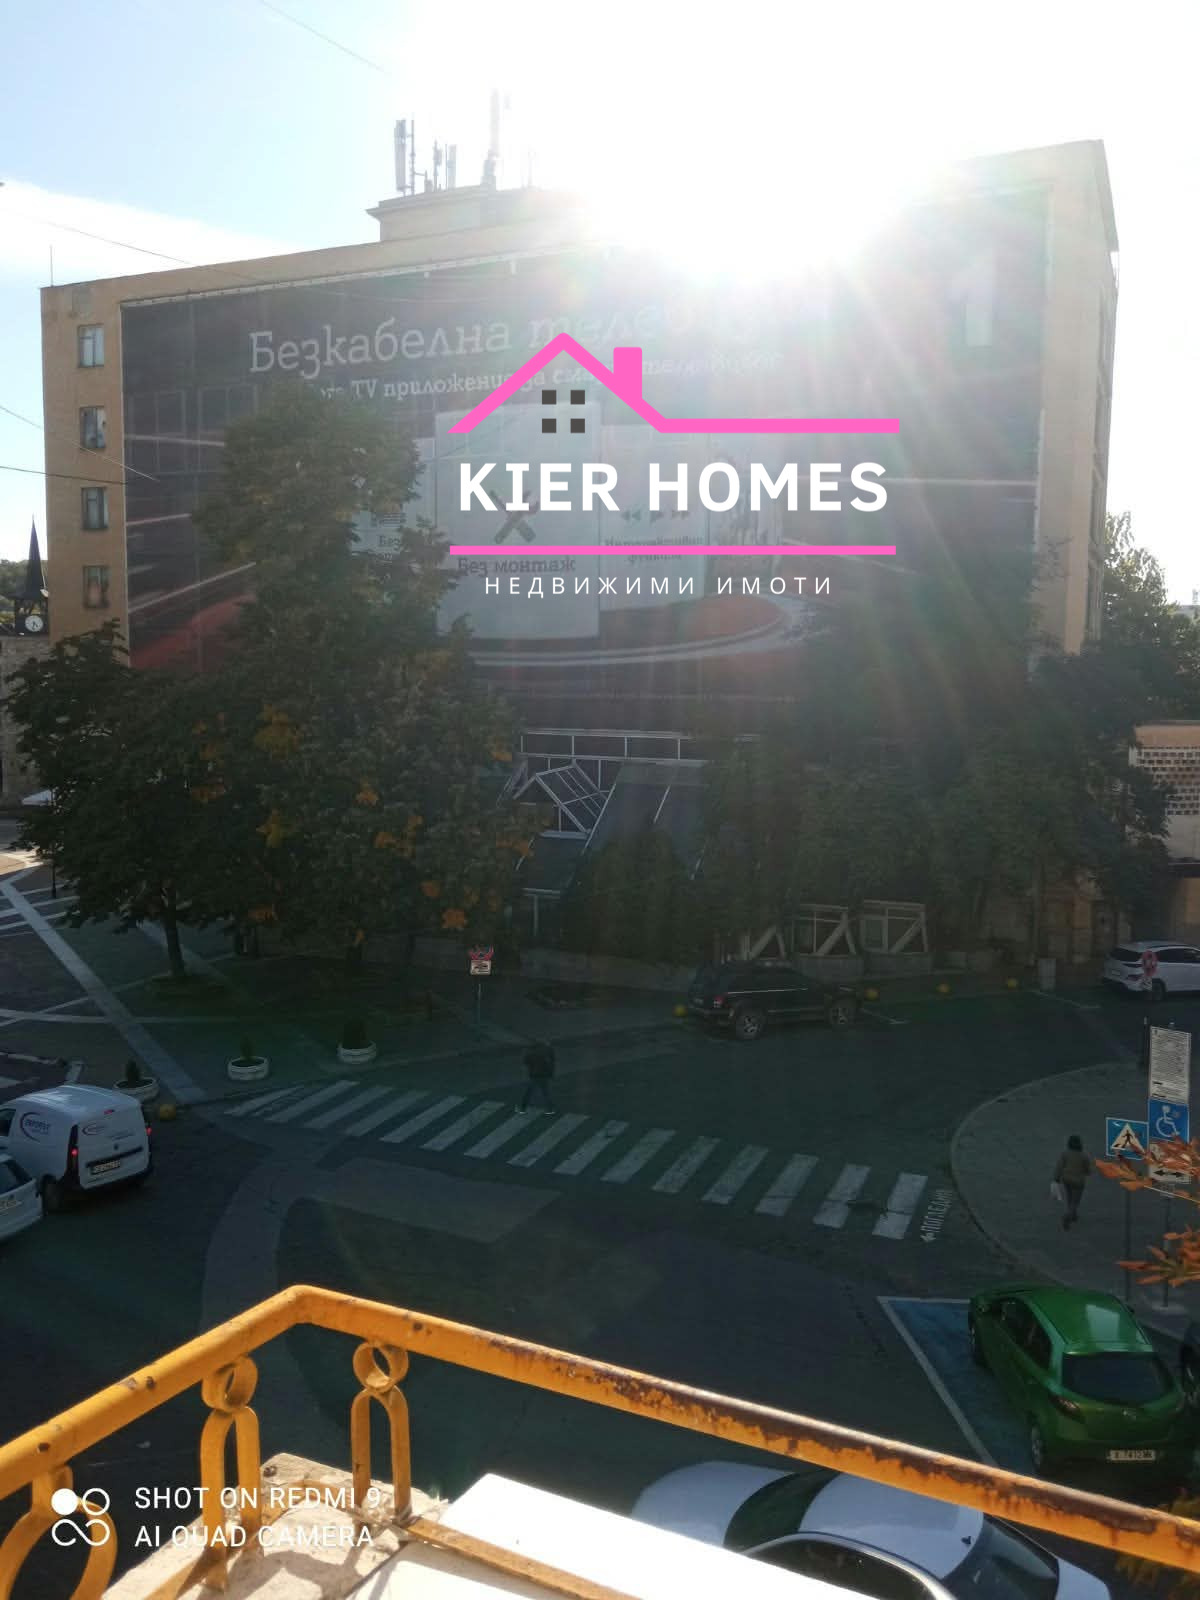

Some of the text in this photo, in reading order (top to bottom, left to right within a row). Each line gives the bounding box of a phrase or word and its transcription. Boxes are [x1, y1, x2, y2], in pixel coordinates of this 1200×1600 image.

[249, 316, 511, 380] Безкабелна
[352, 379, 378, 398] TV
[384, 372, 516, 400] приложени
[495, 556, 576, 573] монтаж
